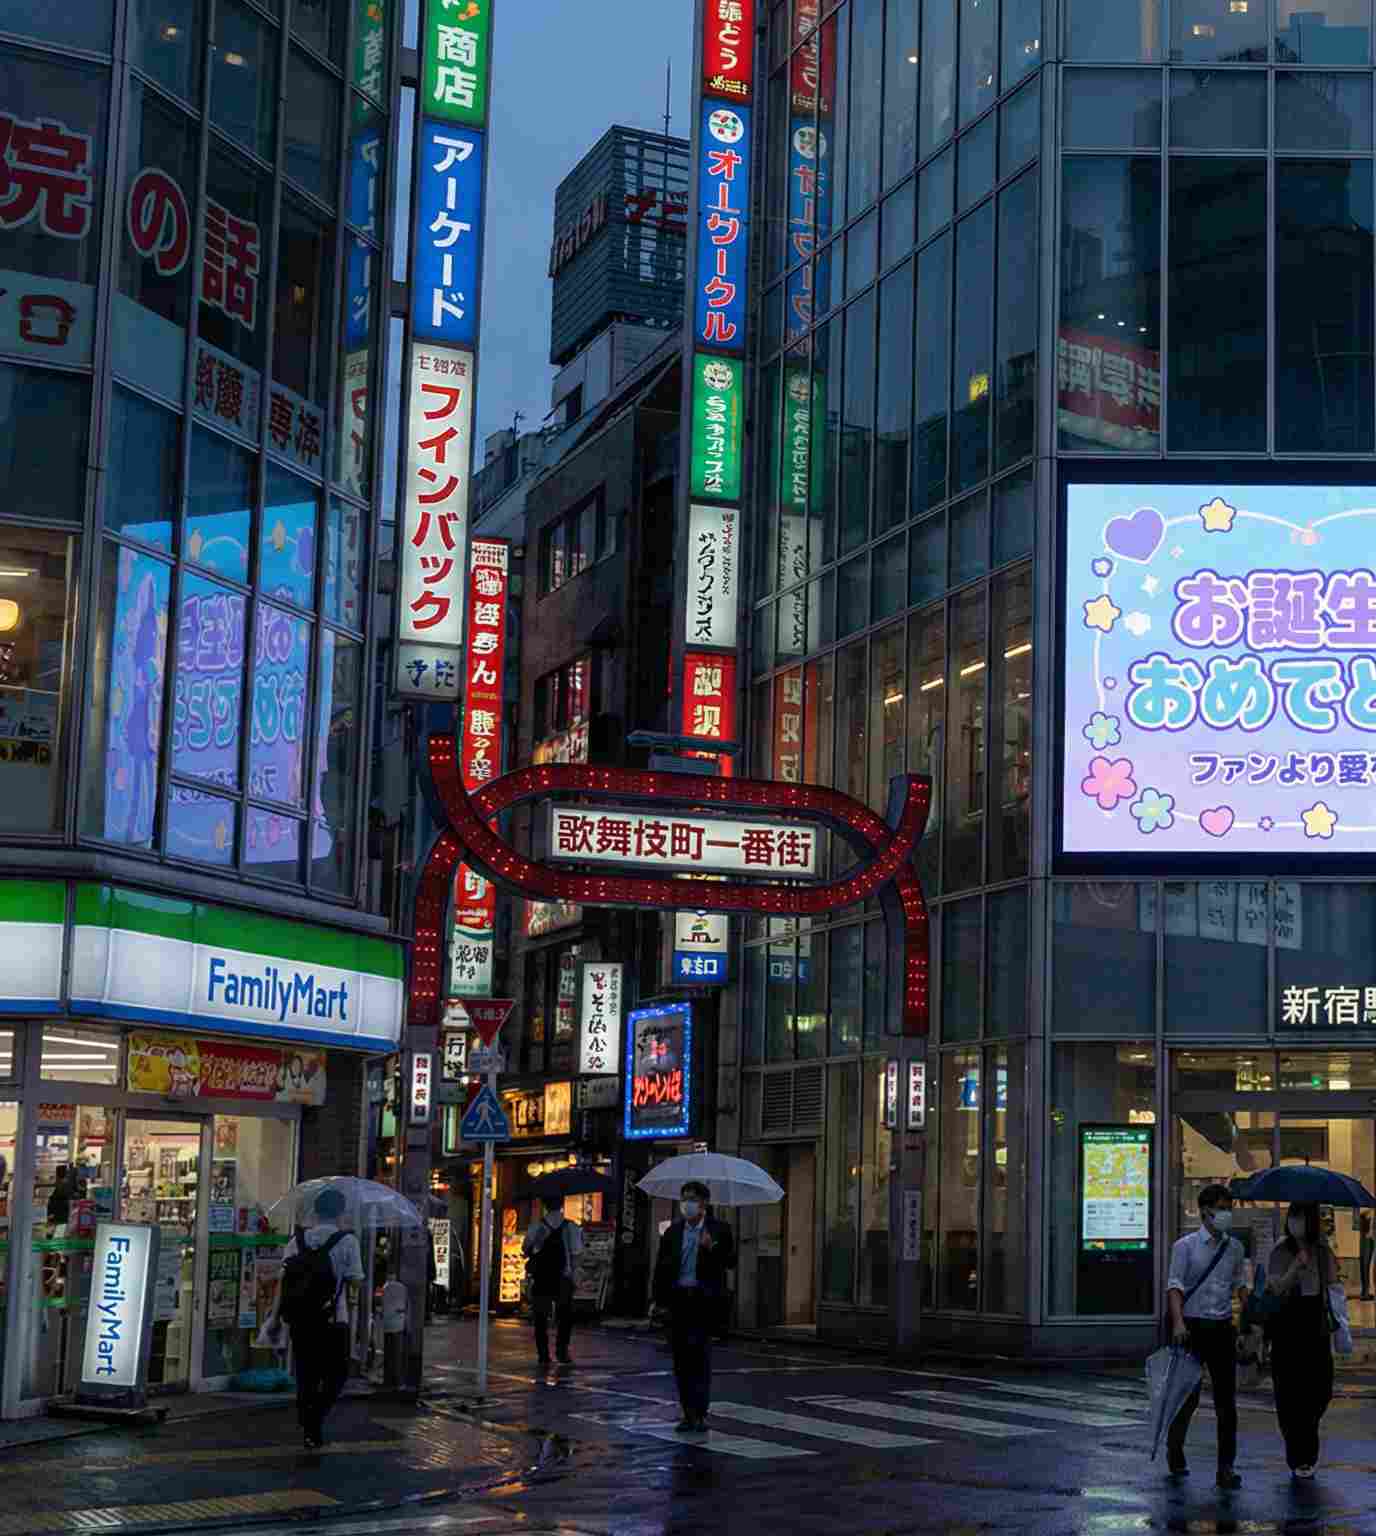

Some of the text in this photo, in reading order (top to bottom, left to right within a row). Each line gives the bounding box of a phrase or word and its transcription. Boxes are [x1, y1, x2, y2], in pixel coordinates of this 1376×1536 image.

[429, 134, 475, 329] アーケード
[207, 957, 348, 1021] FamilyMart
[95, 1236, 130, 1377] FamilyMart
